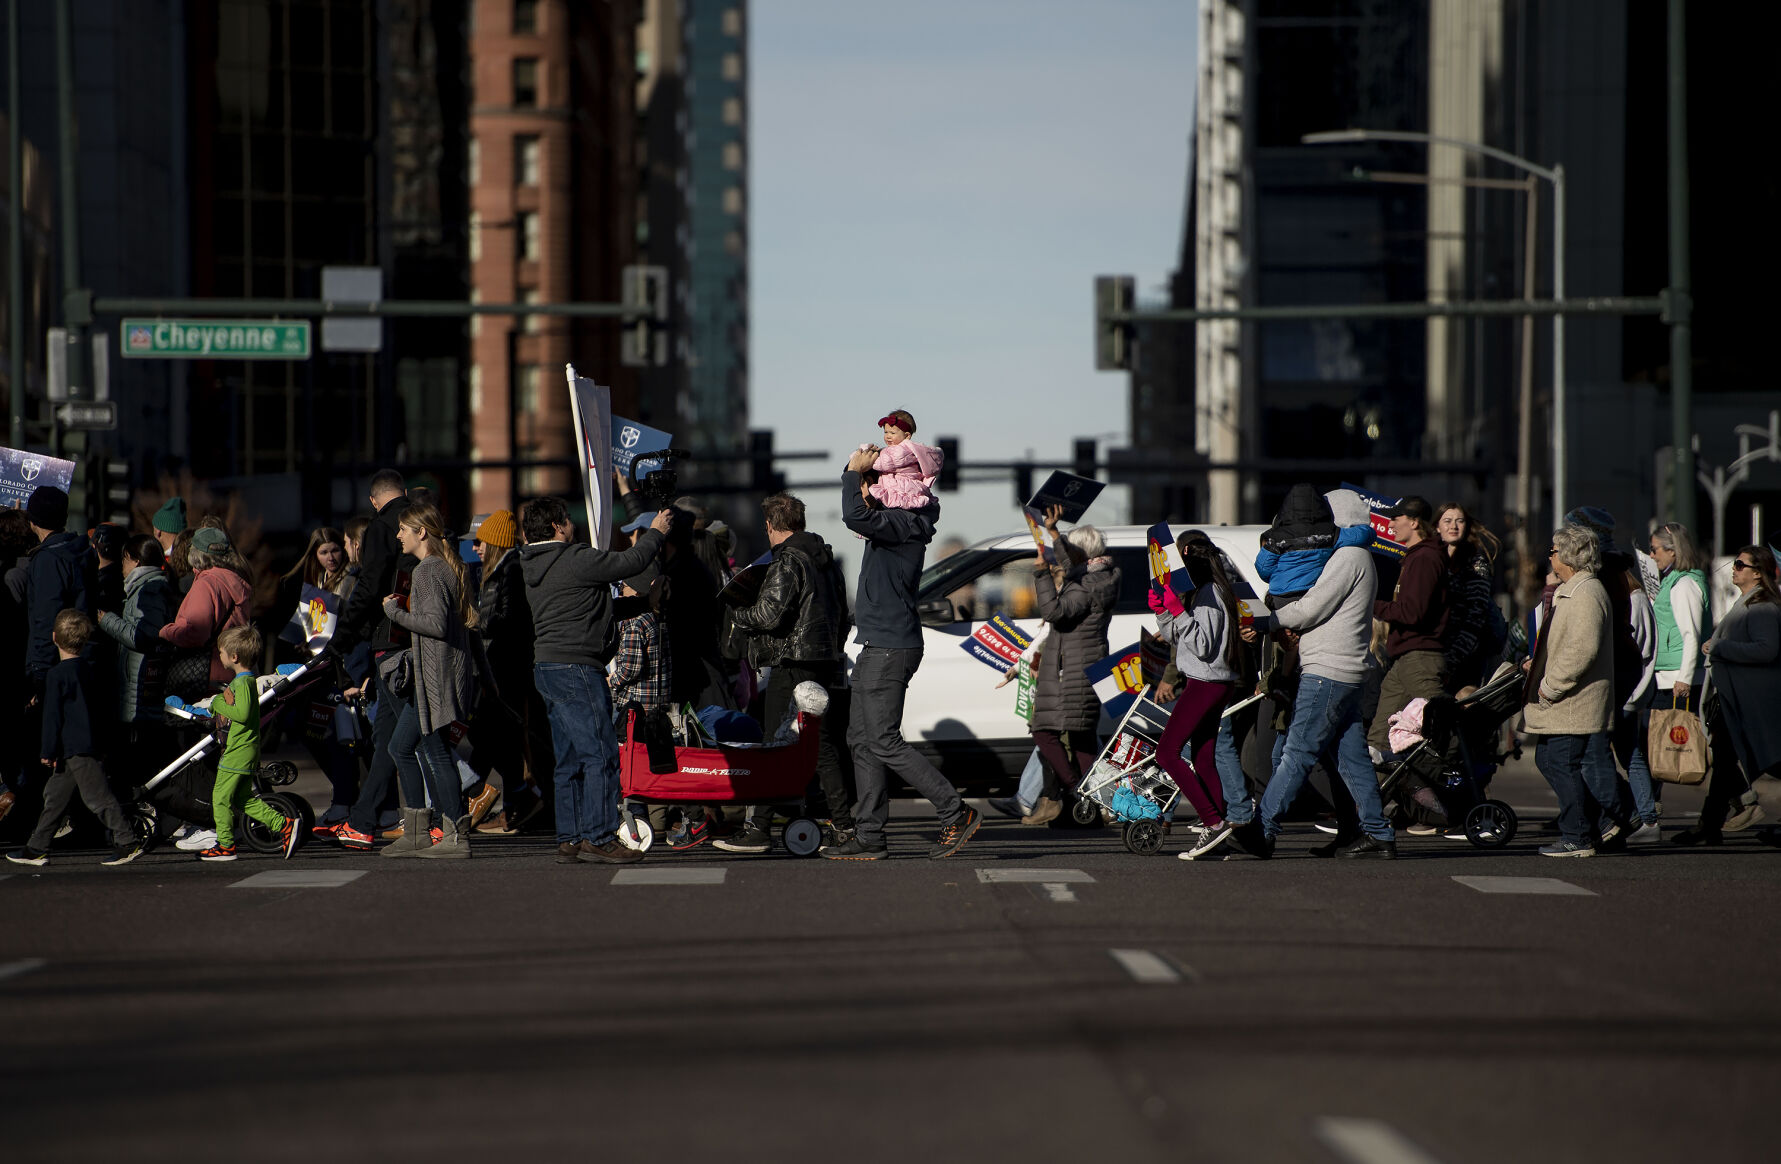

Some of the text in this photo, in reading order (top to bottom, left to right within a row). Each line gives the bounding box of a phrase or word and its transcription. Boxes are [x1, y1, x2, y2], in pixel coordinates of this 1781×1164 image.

[154, 322, 277, 354] Cheyenne
[1376, 523, 1386, 532] to
[1111, 656, 1144, 693] lif
[1017, 661, 1031, 717] LOVE LIFE
[312, 710, 329, 721] Text
[717, 768, 751, 776] FLYER
